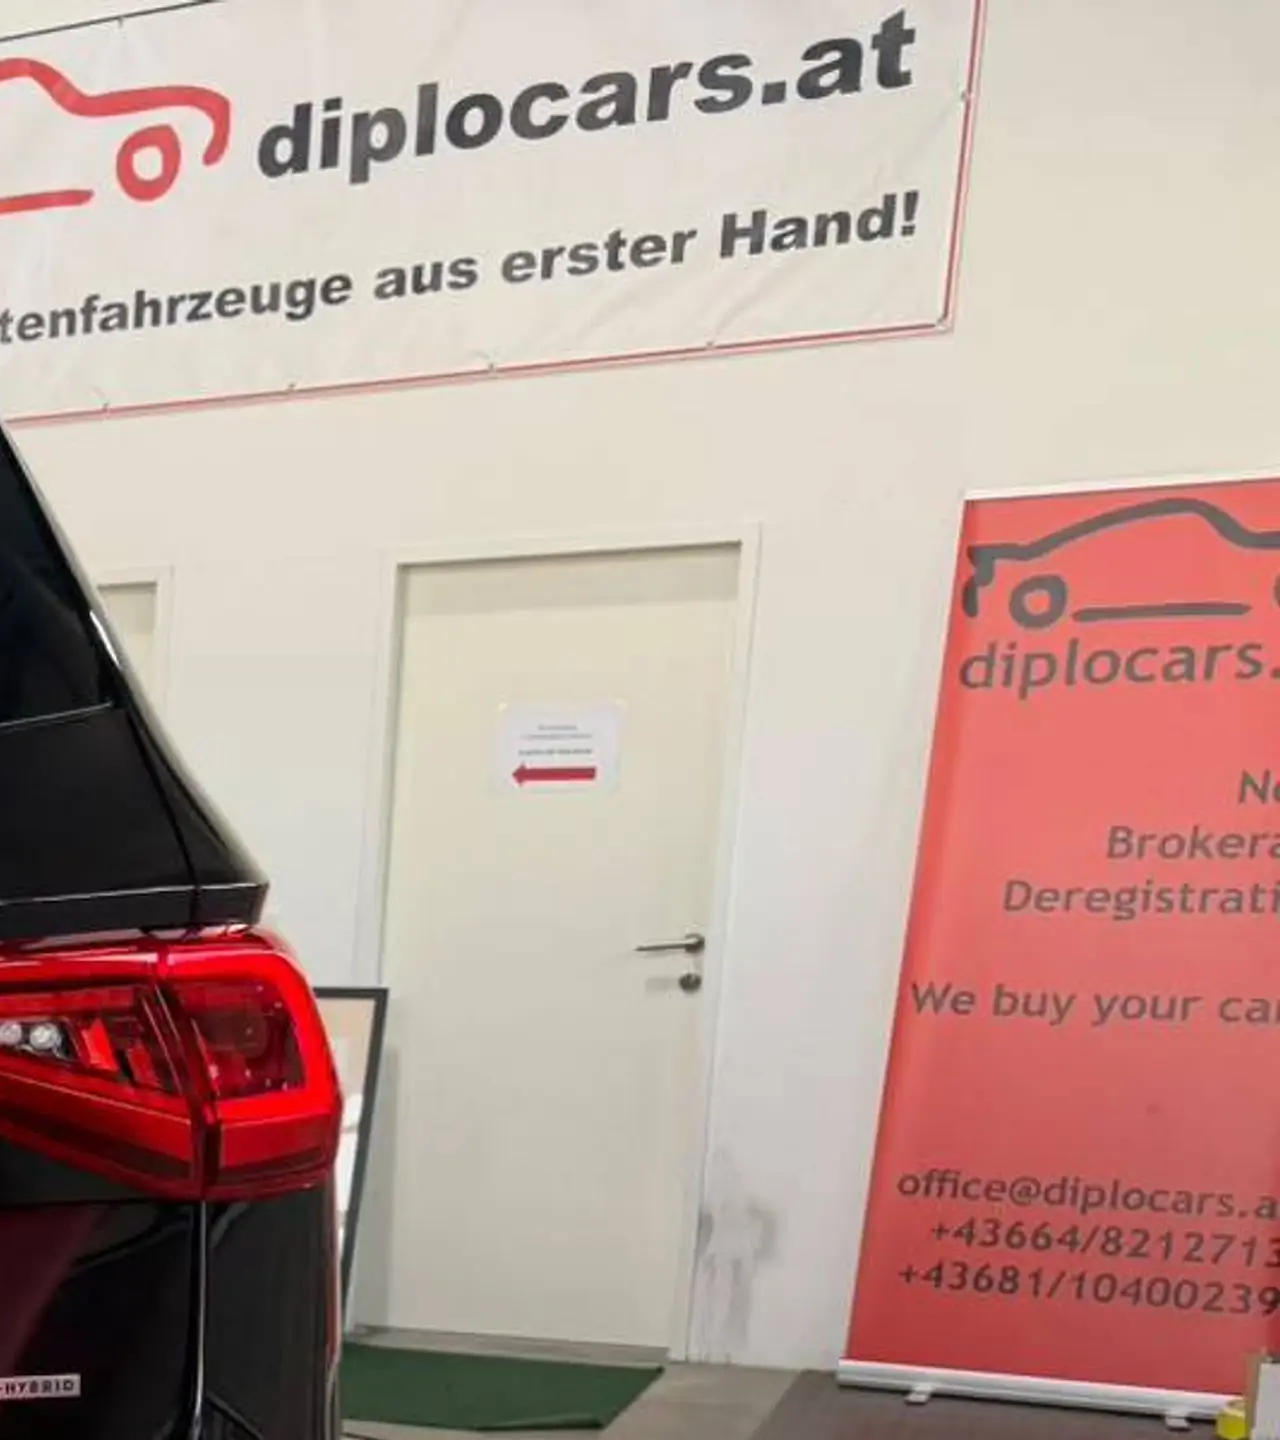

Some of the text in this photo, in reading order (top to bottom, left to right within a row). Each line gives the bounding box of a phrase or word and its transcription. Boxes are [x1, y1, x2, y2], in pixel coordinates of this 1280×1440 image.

[256, 10, 916, 184] diplocars.at
[374, 256, 477, 301] aus
[501, 227, 697, 284] erster
[719, 190, 919, 258] Hand!
[912, 981, 1280, 1026] We buy your ca
